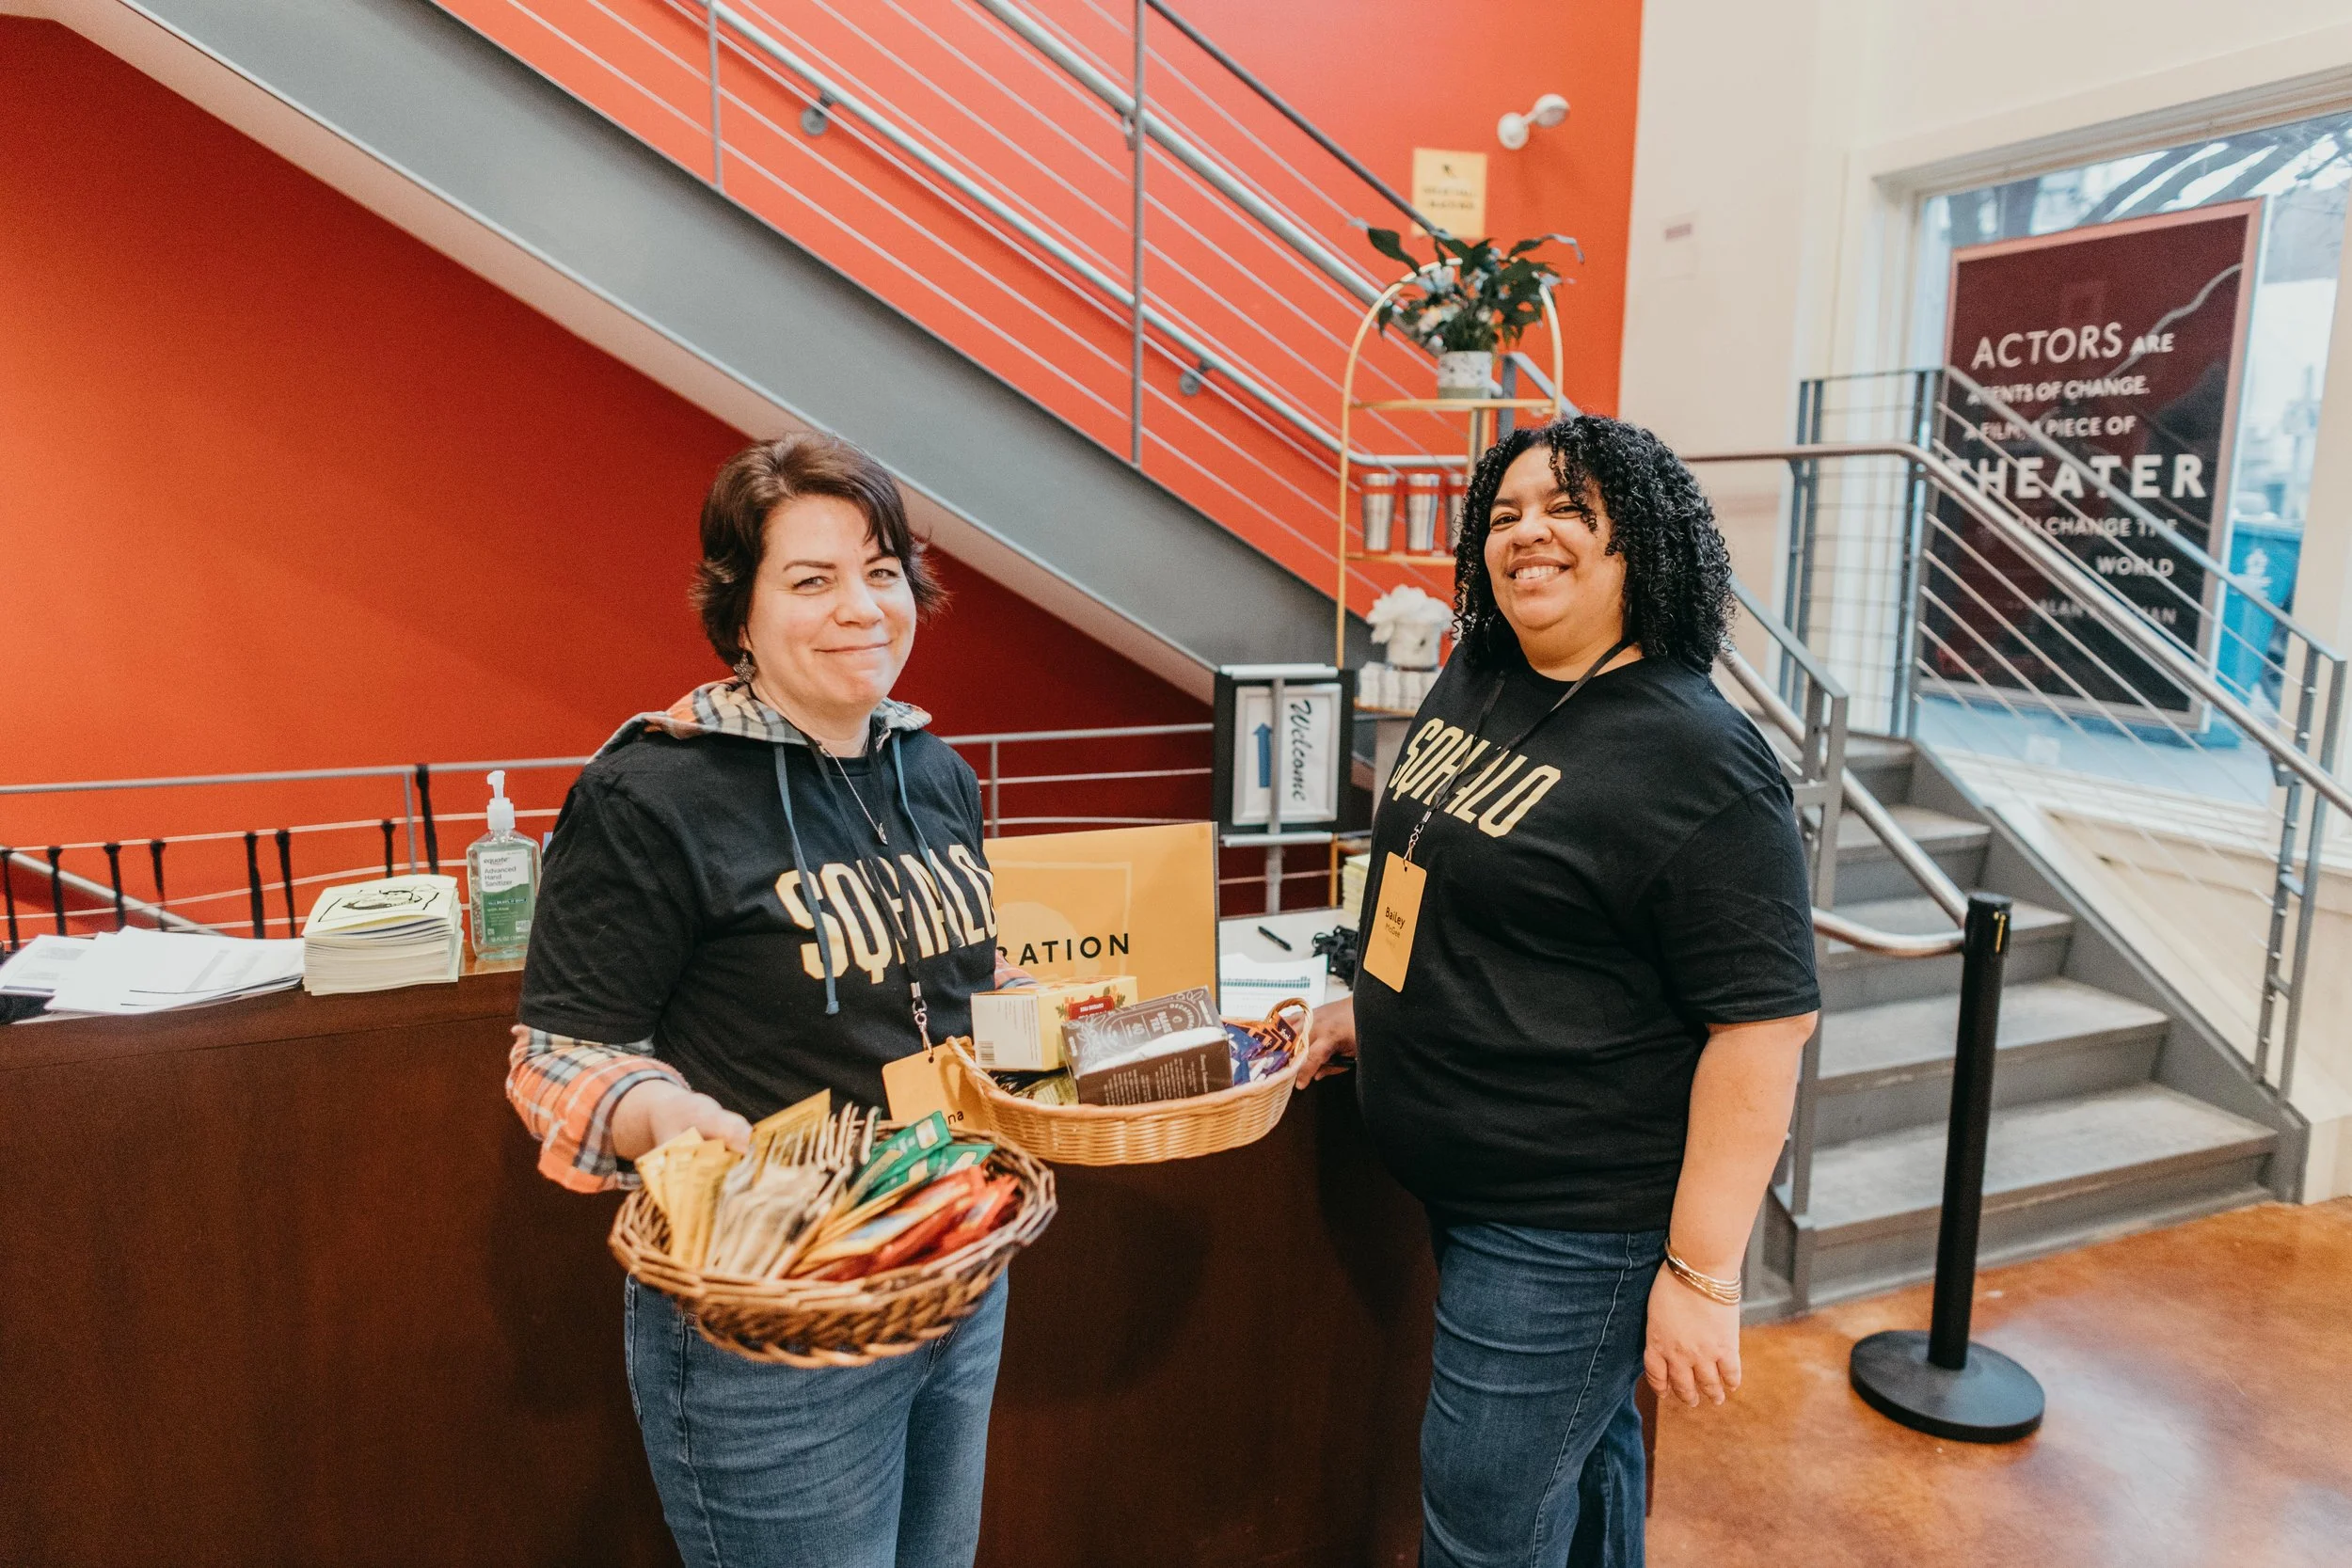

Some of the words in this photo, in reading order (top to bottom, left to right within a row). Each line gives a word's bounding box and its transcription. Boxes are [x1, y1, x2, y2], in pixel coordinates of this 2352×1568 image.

[1970, 322, 2122, 370] ACTORS
[2129, 333, 2175, 356] ARE
[2035, 381, 2062, 402] OF
[2045, 417, 2102, 438] PIECE
[2105, 415, 2137, 436] OF
[2043, 516, 2132, 538] CHANGE
[2095, 555, 2175, 578] WORLD
[1290, 699, 1313, 801] Welcome
[1386, 907, 1406, 929] Bailey
